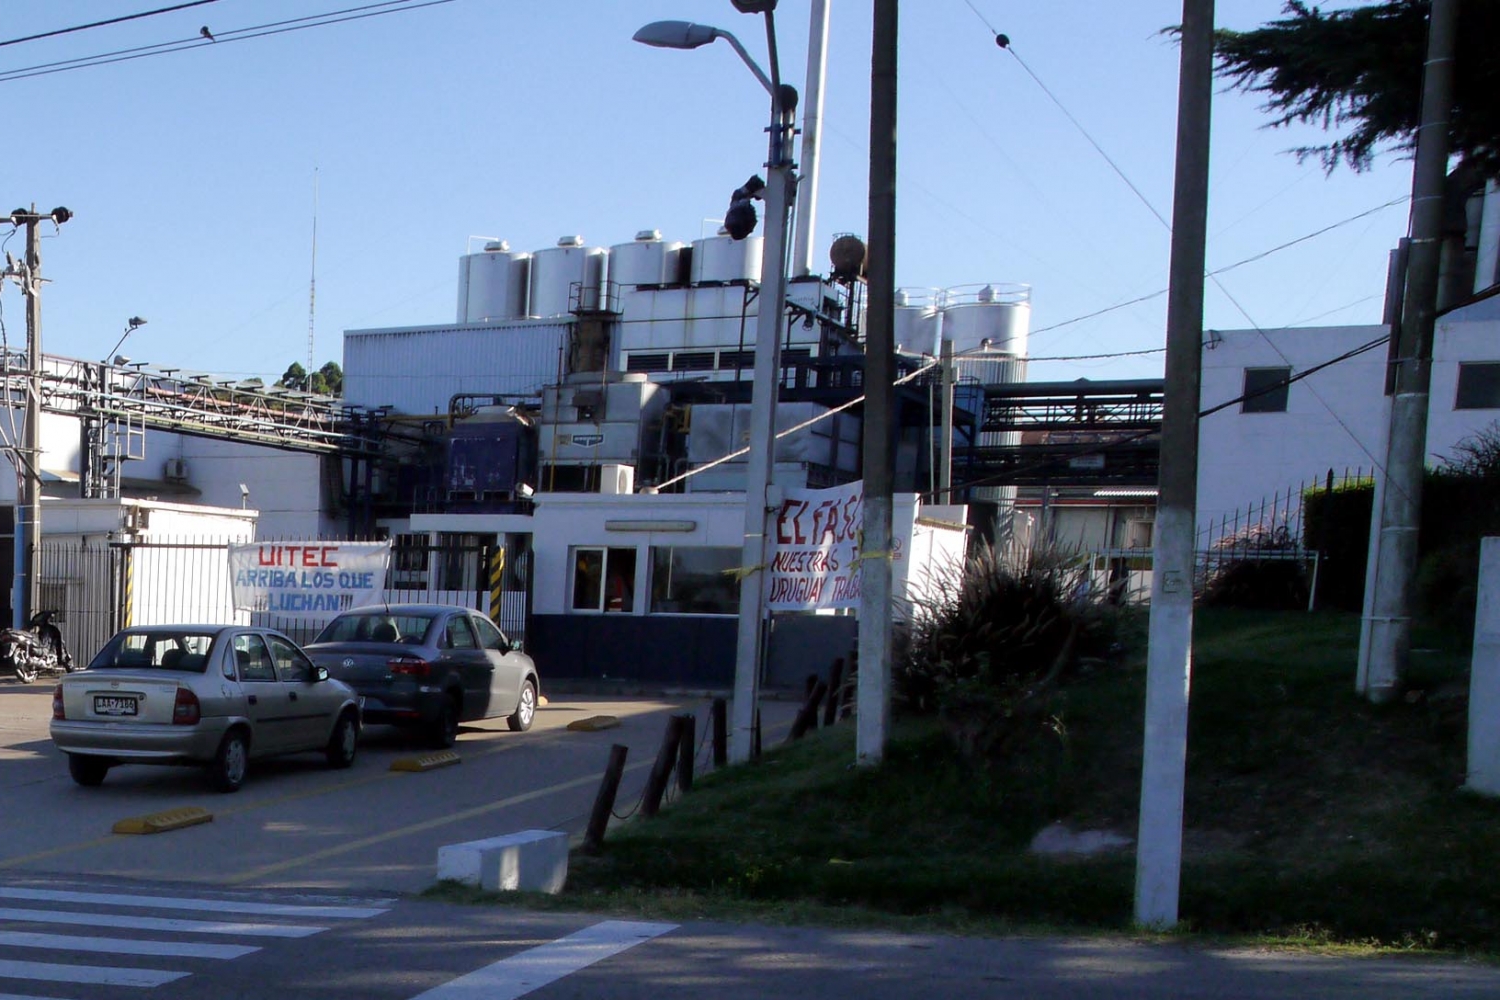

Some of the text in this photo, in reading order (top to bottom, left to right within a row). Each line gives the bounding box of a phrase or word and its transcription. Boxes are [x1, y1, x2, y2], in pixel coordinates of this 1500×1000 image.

[776, 499, 809, 544] EL
[258, 545, 339, 567] UITEC
[770, 550, 839, 573] NUESTRAS
[235, 569, 374, 588] ARRIBA LOS QUE
[769, 577, 828, 604] URUGUAY
